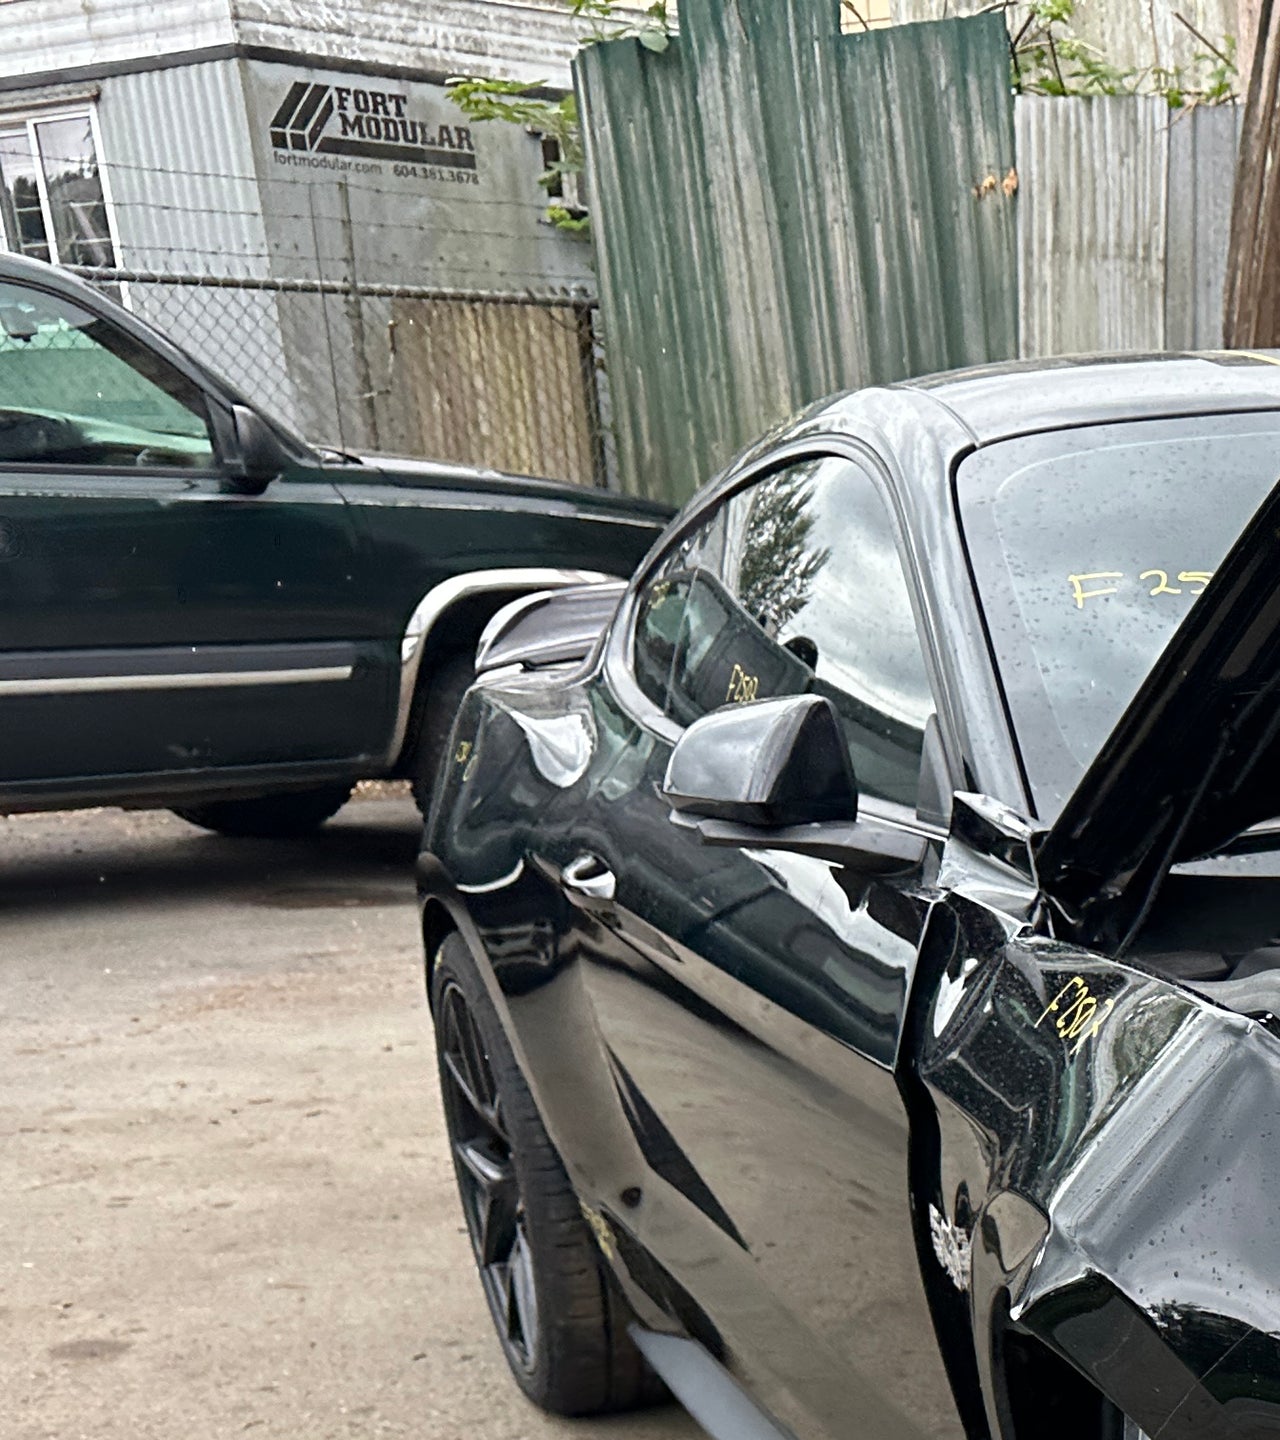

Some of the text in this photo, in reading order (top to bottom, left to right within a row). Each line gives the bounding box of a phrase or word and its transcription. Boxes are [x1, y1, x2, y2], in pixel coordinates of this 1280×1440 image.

[335, 87, 407, 117] FORT
[339, 112, 474, 150] MODULAR
[273, 151, 382, 174] fortmodular.com
